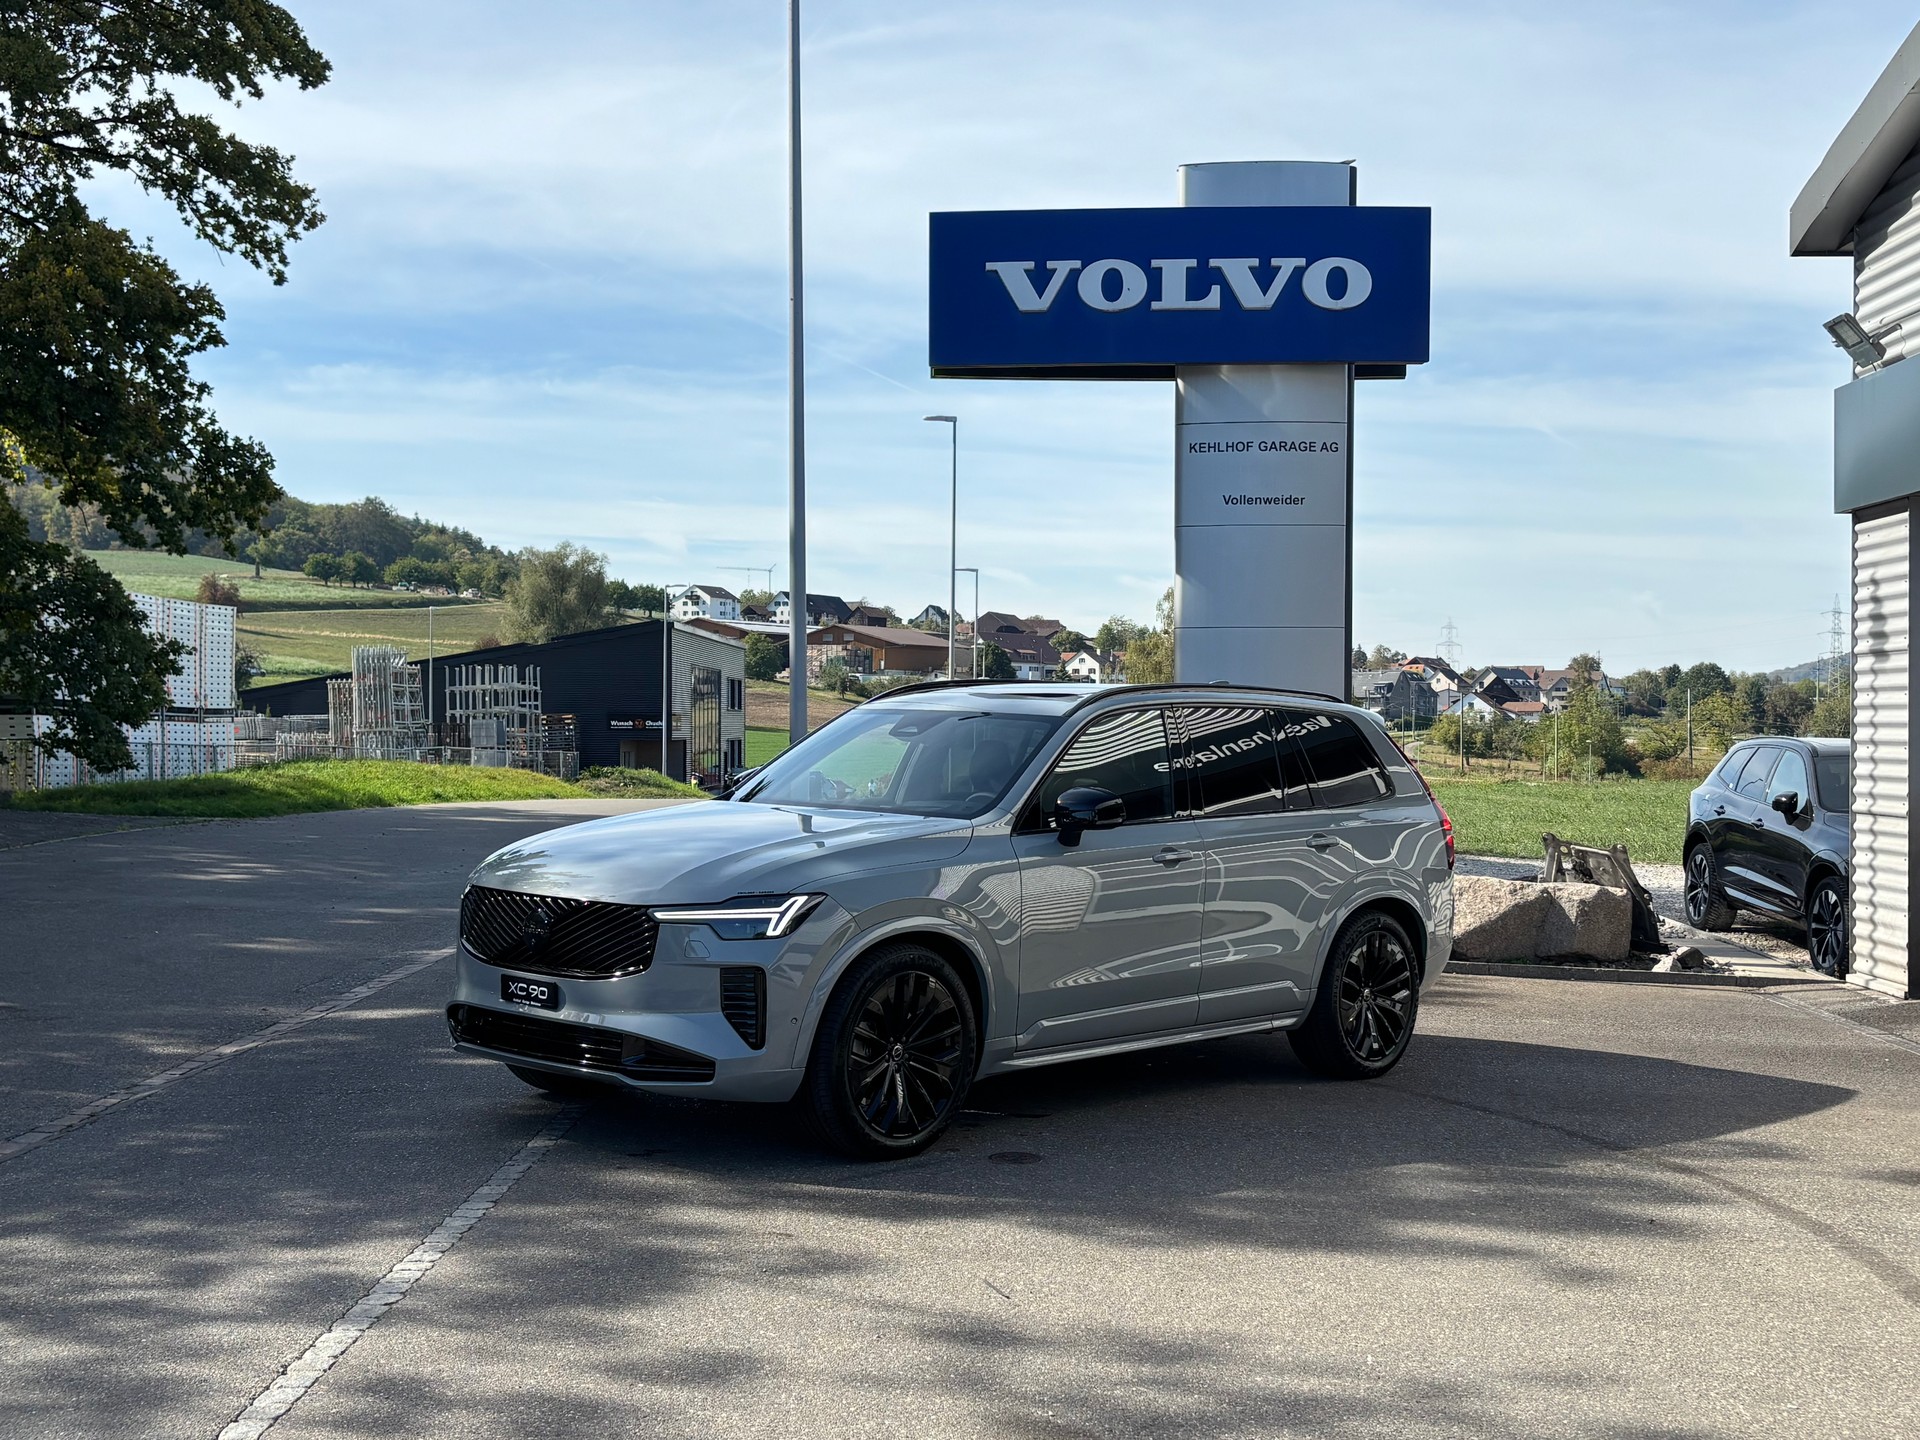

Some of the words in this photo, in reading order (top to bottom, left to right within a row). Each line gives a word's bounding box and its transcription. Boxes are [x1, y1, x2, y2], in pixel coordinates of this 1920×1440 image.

[985, 257, 1372, 312] VOLVO
[1189, 441, 1254, 454] KEHLHOF
[1258, 441, 1317, 453] GARAGE
[1320, 441, 1339, 453] AG
[1222, 494, 1306, 506] Vollenweider
[508, 981, 548, 999] XC90
